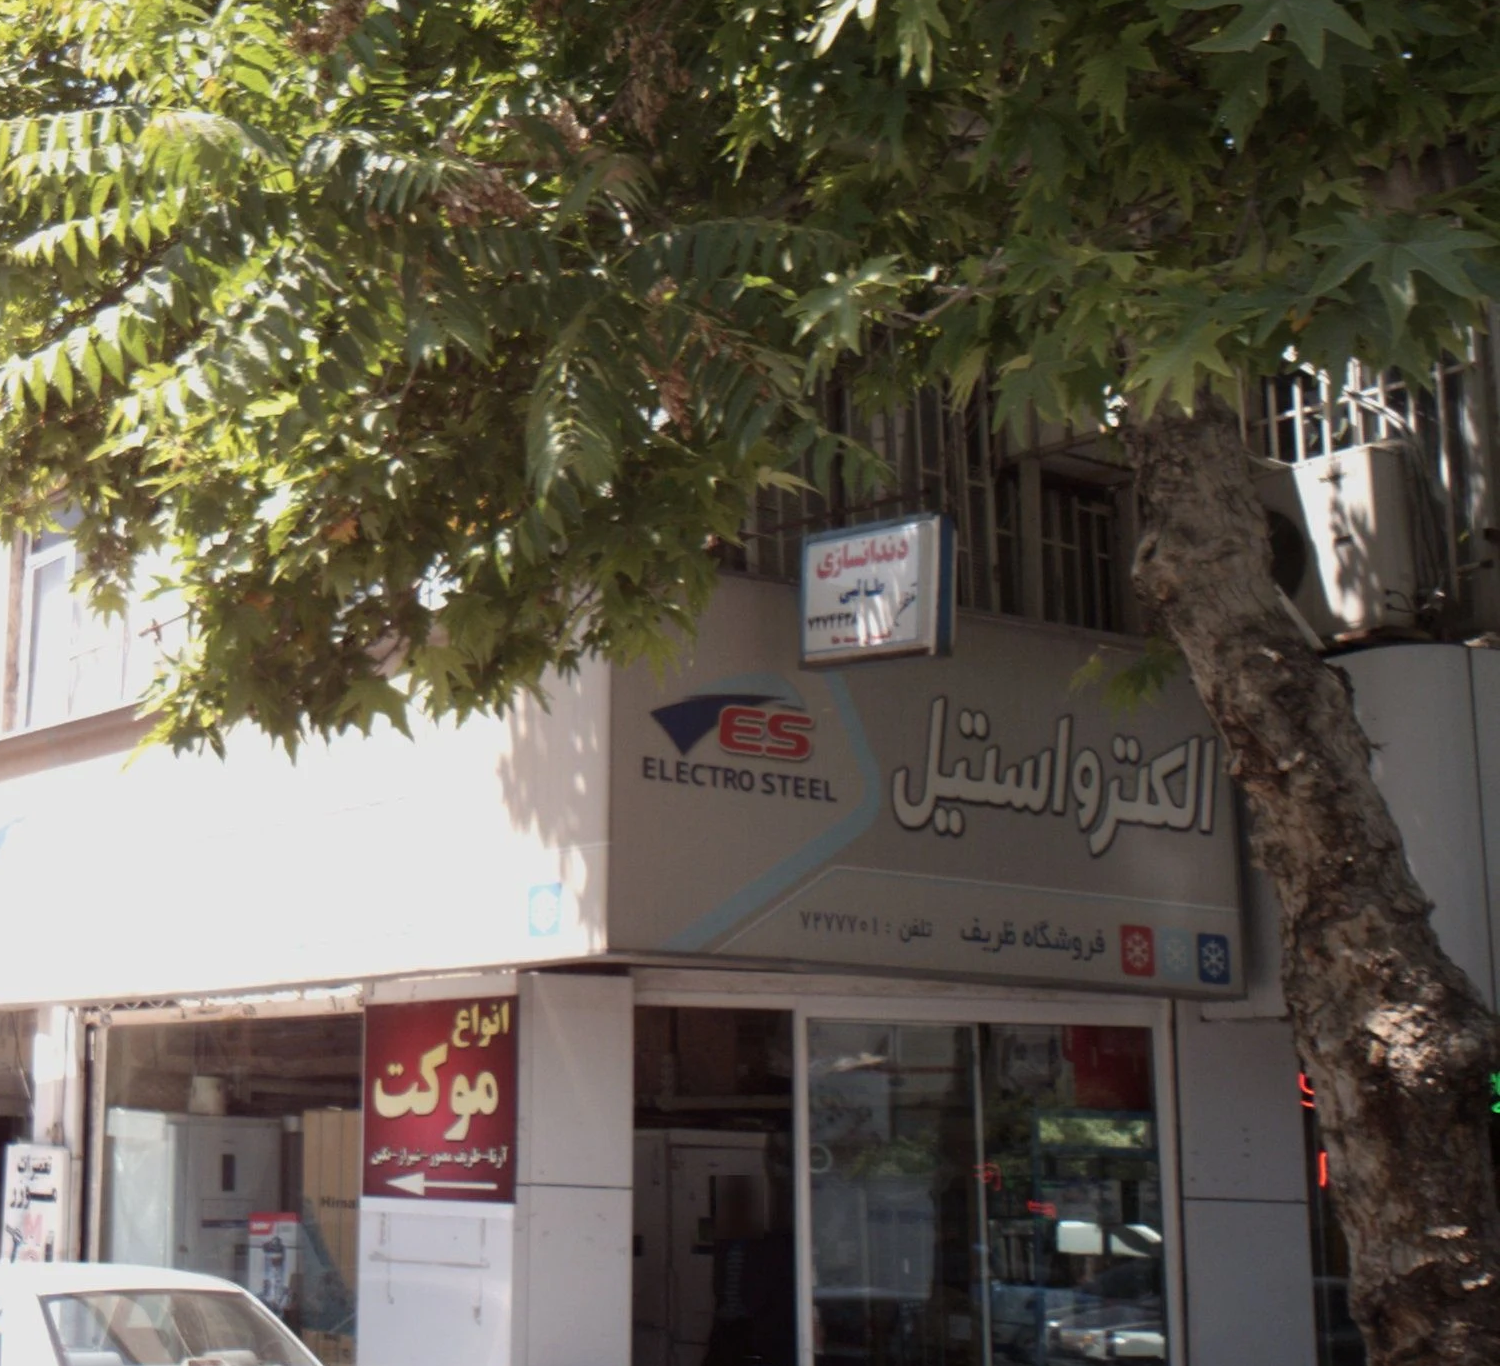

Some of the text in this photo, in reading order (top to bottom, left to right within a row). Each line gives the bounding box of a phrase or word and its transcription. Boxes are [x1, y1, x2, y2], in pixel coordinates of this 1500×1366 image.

[816, 535, 908, 579] دندانسازی
[719, 705, 814, 760] ES
[642, 756, 838, 803] ELECTRO STEEL
[960, 916, 1016, 953] ظریف
[1023, 919, 1106, 961] فروشگاه
[452, 1001, 510, 1048] انواع
[374, 1043, 499, 1141] موکت
